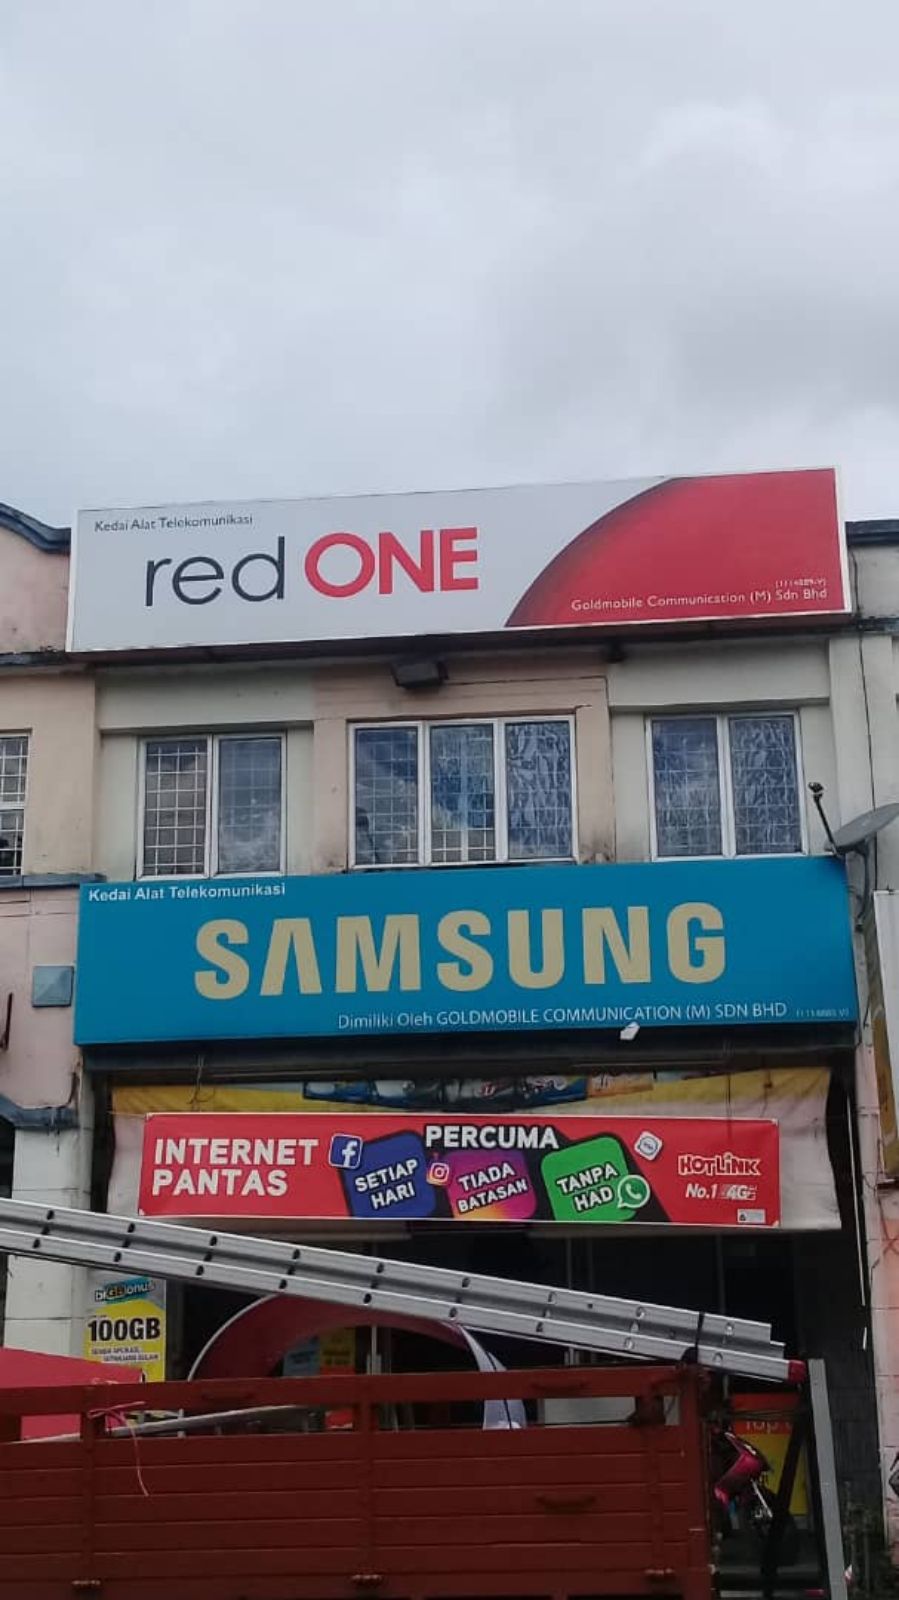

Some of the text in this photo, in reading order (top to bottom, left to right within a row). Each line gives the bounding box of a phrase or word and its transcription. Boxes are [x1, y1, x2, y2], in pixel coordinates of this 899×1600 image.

[94, 514, 253, 532] Kedai Alat Telekomunikasi
[145, 526, 479, 607] red ONE
[571, 587, 828, 612] Goldmobile Communication (M) Sdn Bhd
[89, 882, 286, 902] Kedai Alat Telekomunikasi
[194, 901, 726, 1000] SAMSUNG
[338, 1012, 393, 1029] Dimiliki
[397, 1011, 433, 1027] Oleh
[437, 1007, 539, 1026] GOLDMOBILE
[543, 1004, 682, 1023] COMMUNICATION
[686, 1005, 711, 1020] (M)
[717, 1003, 749, 1017] SDN
[753, 1002, 787, 1017] BHD
[425, 1125, 560, 1149] PERCUMA
[155, 1138, 318, 1165] INTERNET
[152, 1168, 288, 1197] PANTAS
[355, 1158, 419, 1192] SETIAP
[457, 1162, 516, 1192] TIADA
[556, 1161, 619, 1195] TANPA
[371, 1182, 415, 1210] HARI
[457, 1179, 528, 1213] BATASAN
[574, 1186, 614, 1212] HAD
[685, 1183, 717, 1199] No.1
[88, 1317, 161, 1342] 100GB
